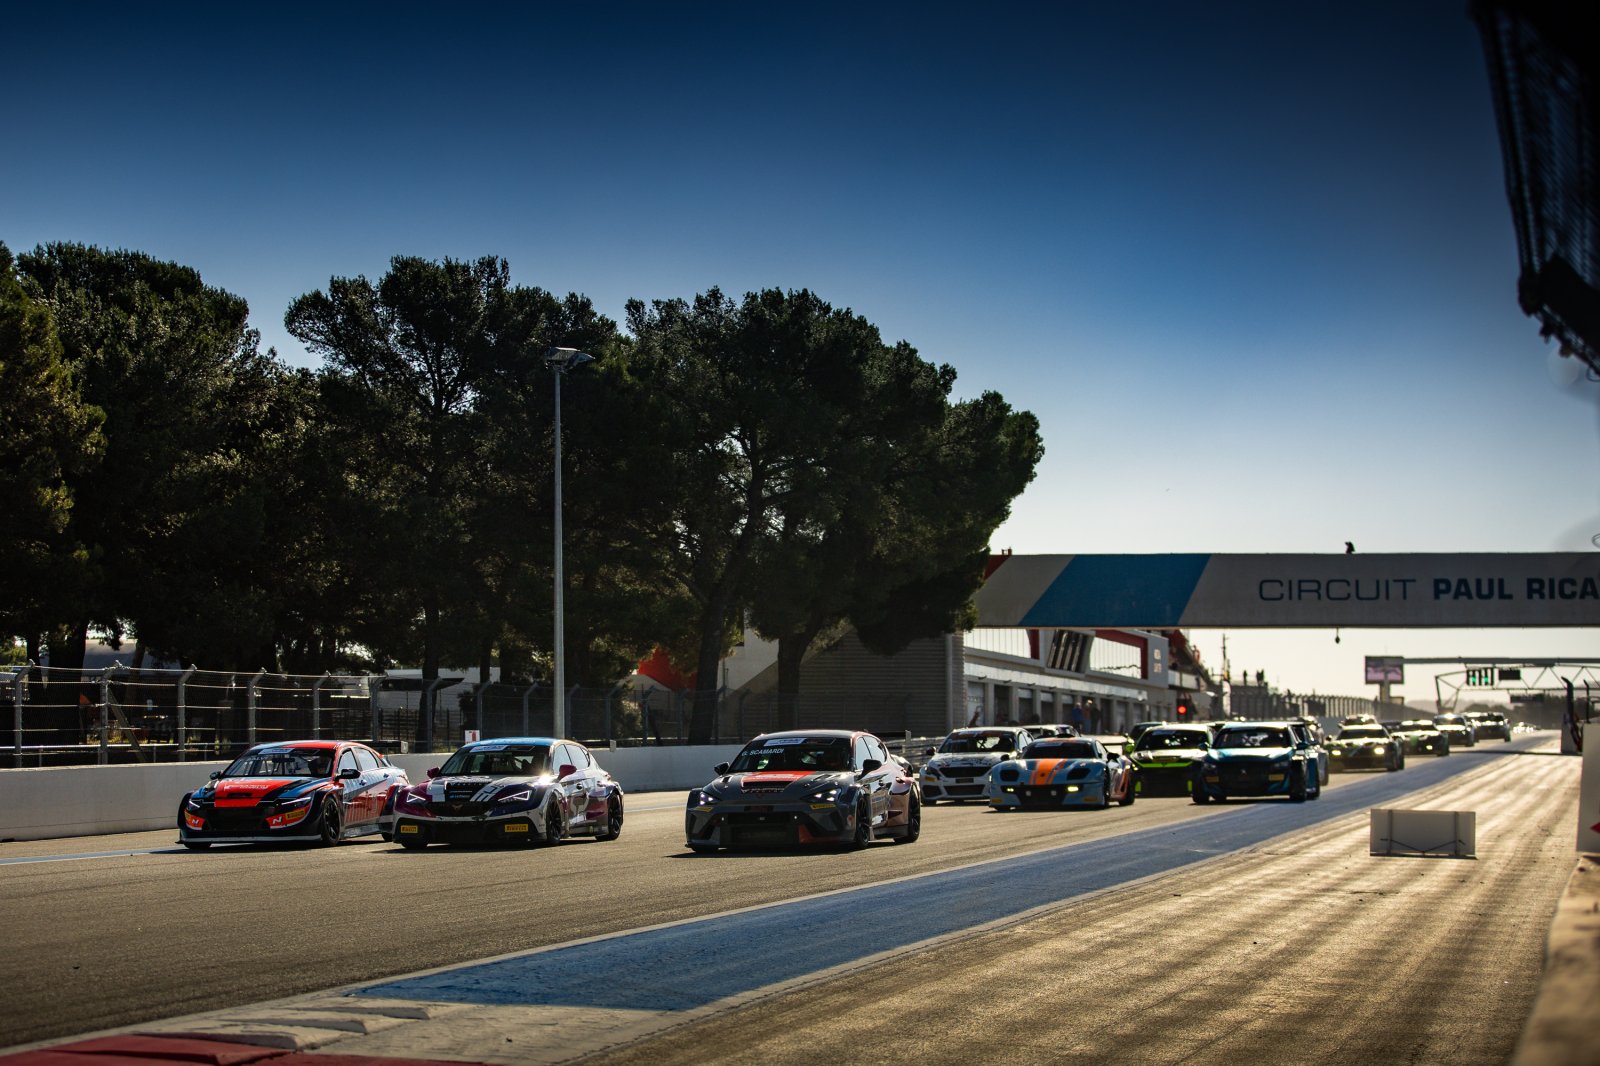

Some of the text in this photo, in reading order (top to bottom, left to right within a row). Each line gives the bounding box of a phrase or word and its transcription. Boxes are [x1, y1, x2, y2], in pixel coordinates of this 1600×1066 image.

[1258, 577, 1600, 601] CIRCUIT PAUL RICA
